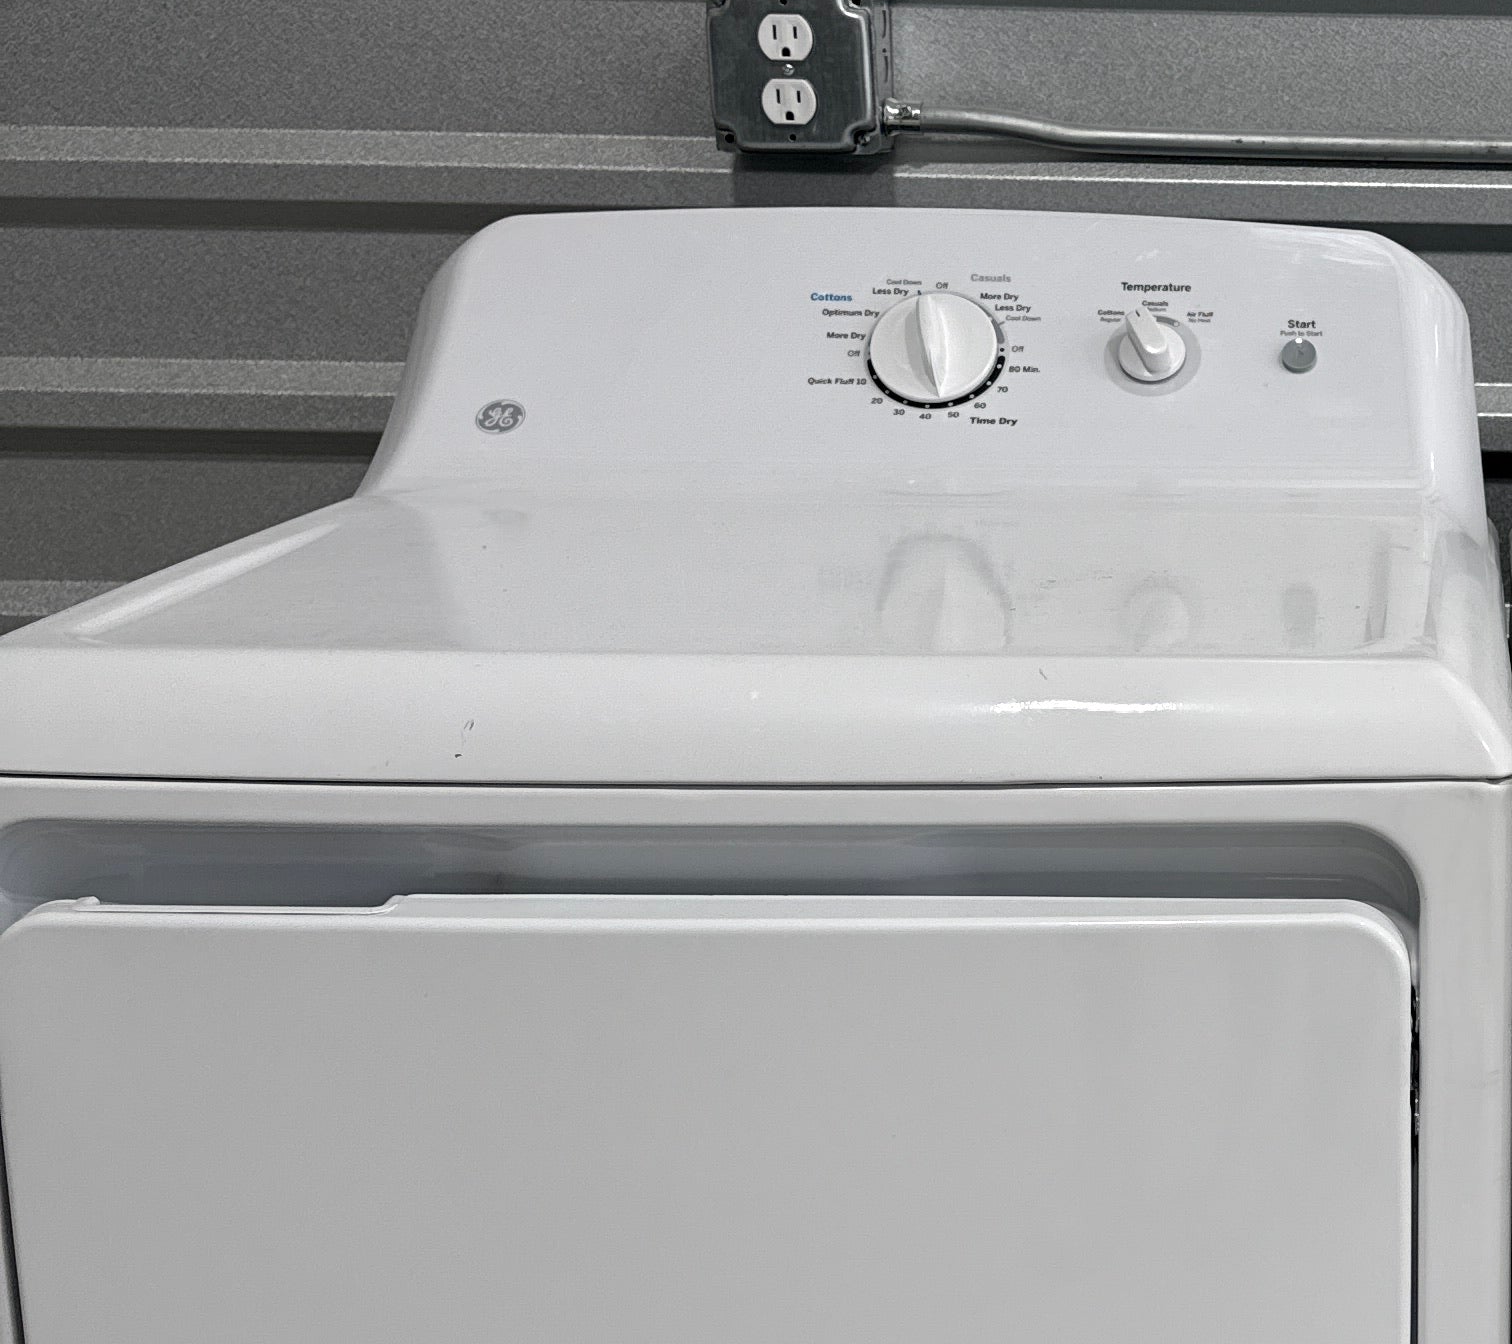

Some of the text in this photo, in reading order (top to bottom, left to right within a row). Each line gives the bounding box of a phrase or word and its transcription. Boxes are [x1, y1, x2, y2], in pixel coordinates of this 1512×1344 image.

[970, 274, 1012, 282] Casuals
[1121, 282, 1192, 292] Temperature
[893, 288, 909, 297] Dry
[810, 293, 853, 302] Cottons
[1004, 293, 1019, 302] Dry
[1016, 304, 1032, 313] Dry
[1288, 320, 1316, 328] Start
[970, 417, 1018, 426] Time Dry
